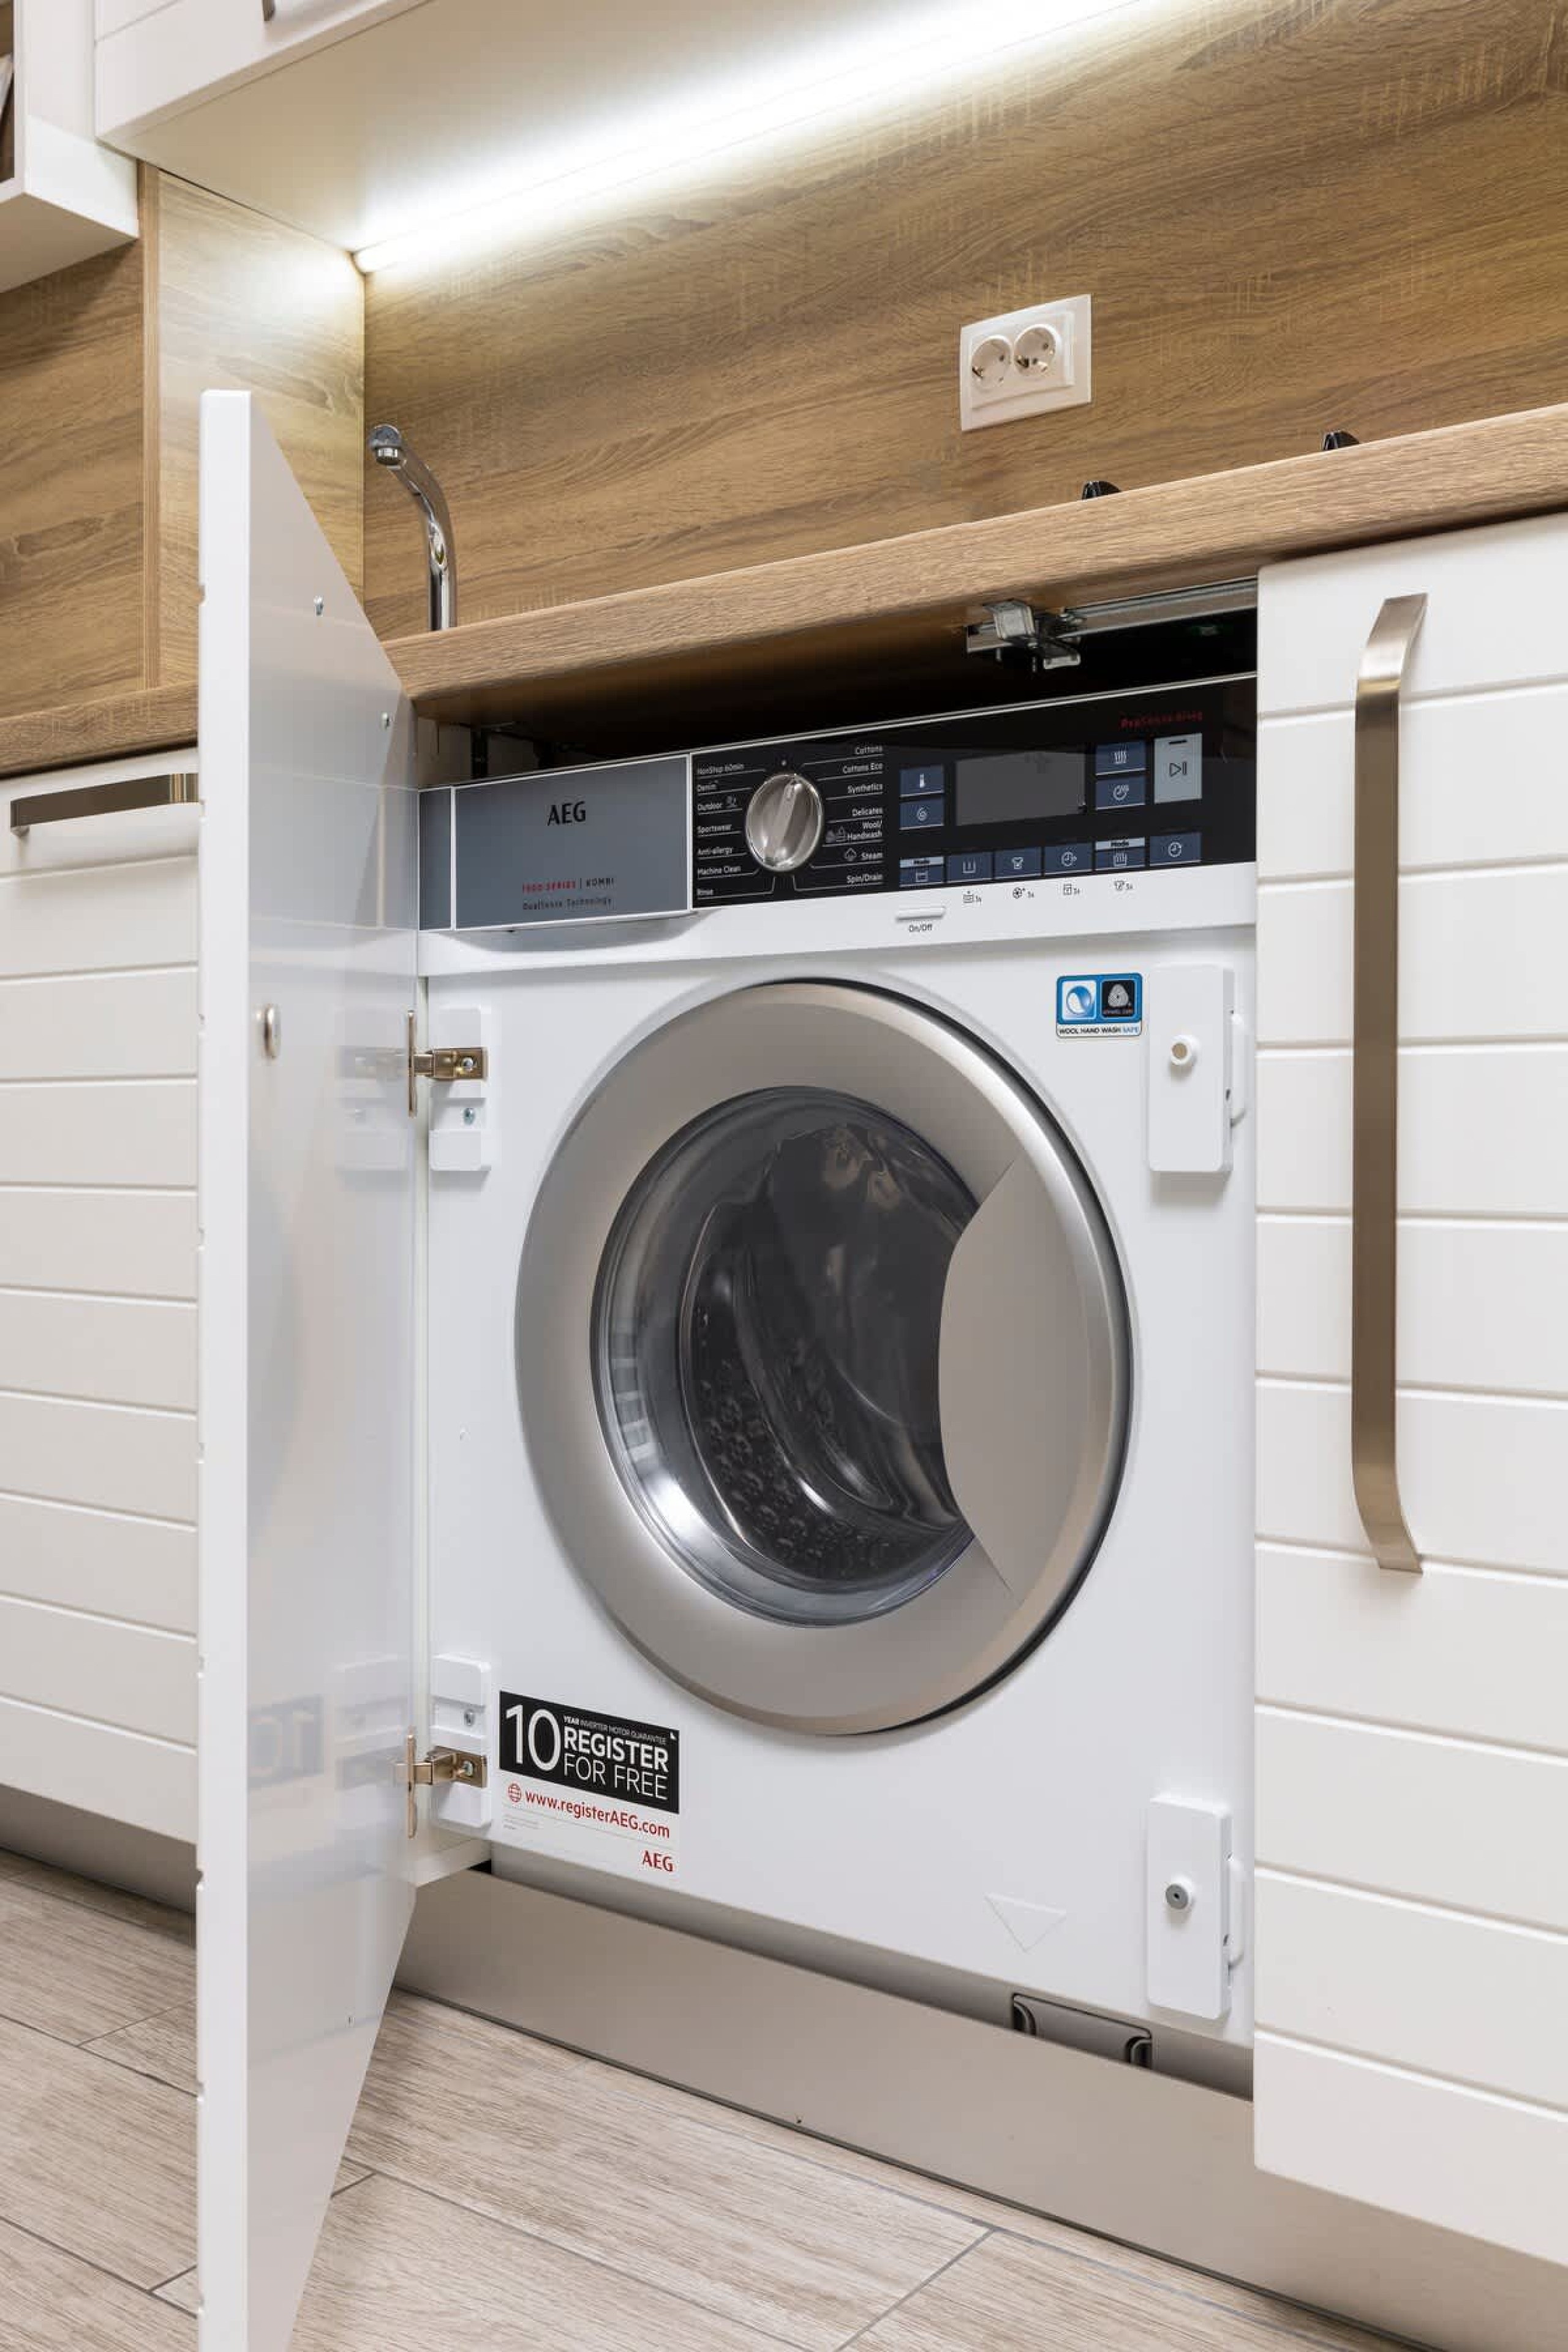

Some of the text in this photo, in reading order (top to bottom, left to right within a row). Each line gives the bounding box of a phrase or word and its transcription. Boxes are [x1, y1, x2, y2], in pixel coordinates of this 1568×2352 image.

[854, 745, 883, 755] Cottons
[842, 764, 869, 774] Cottons
[847, 783, 883, 794] Synthetics
[698, 802, 722, 811] Outdoor
[851, 807, 883, 816] Delicates
[547, 801, 586, 826] AEG
[698, 824, 732, 834] Sportswear
[847, 829, 883, 841] Handwash
[698, 846, 733, 856] Anti-allergy
[846, 873, 883, 884] Spin/Drain
[909, 923, 932, 932] On/Off
[564, 1716, 579, 1725] YEAR
[505, 1705, 561, 1771] 10
[564, 1726, 669, 1773] REGISTER
[564, 1753, 668, 1800] FOR FREE
[525, 1791, 670, 1839] www.registerAEG.com
[642, 1850, 674, 1872] AEG
